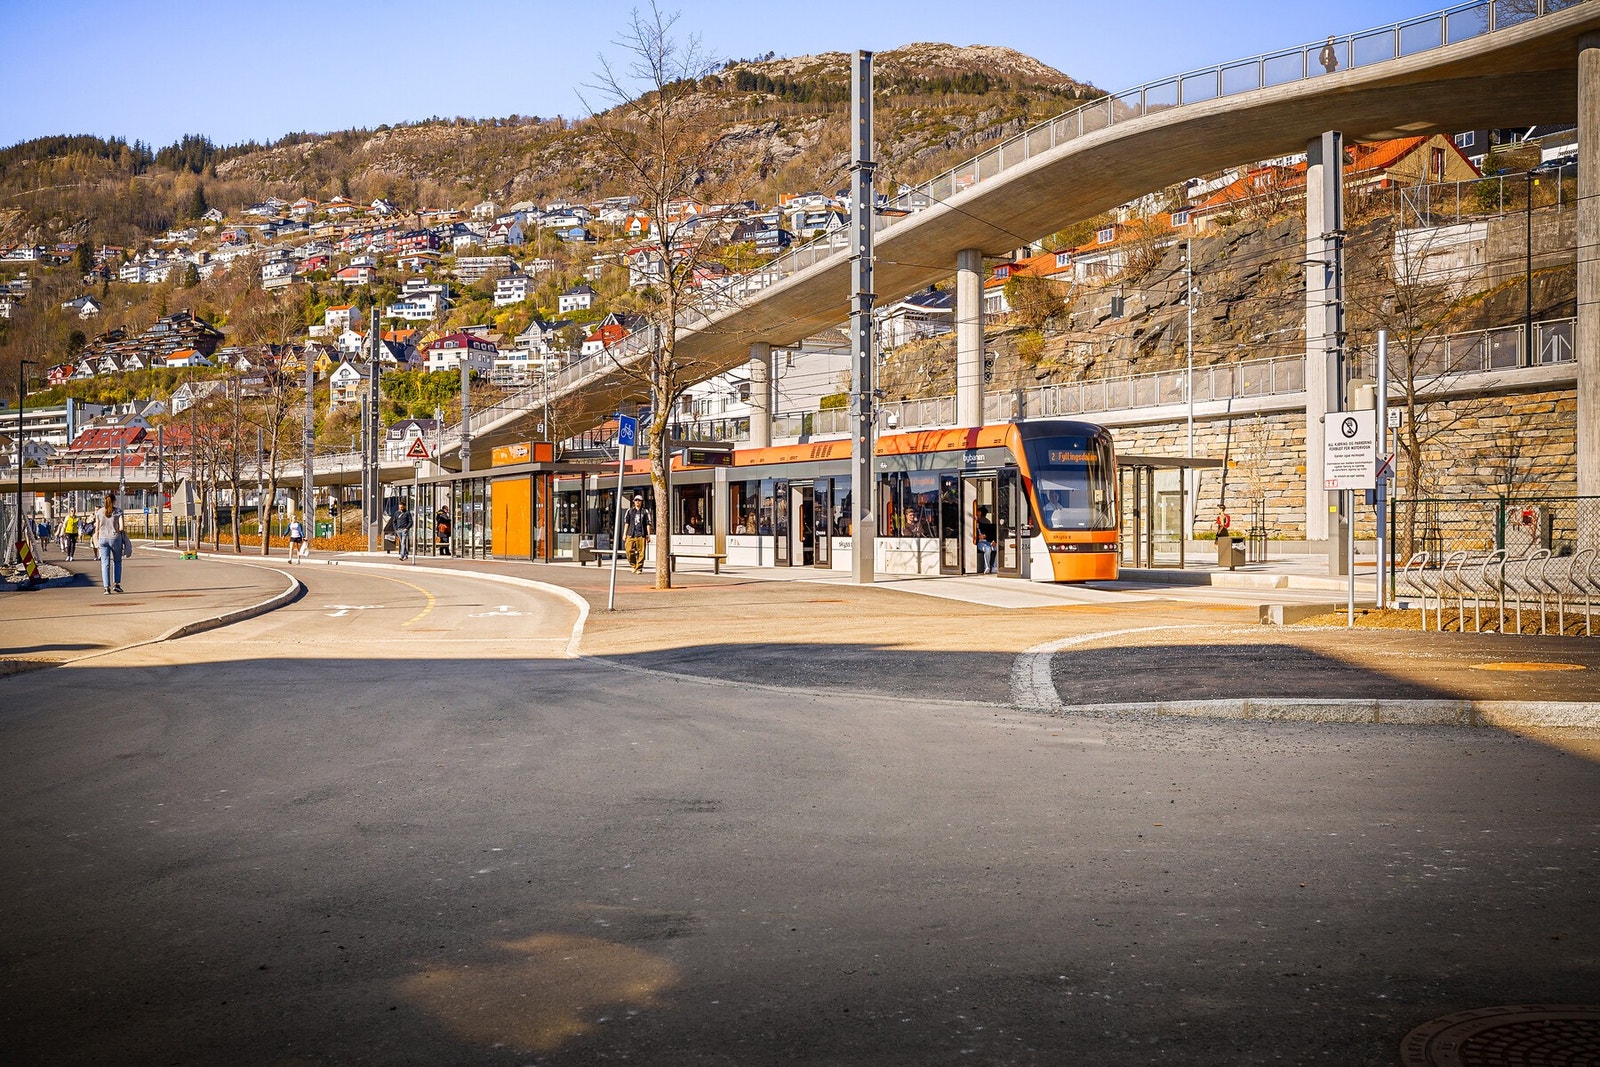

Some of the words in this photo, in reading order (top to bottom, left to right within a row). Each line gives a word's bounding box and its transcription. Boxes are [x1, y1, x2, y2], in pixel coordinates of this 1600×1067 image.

[963, 454, 985, 463] bybanen
[1052, 452, 1055, 460] 2
[1058, 452, 1097, 462] Fyllingsdalen
